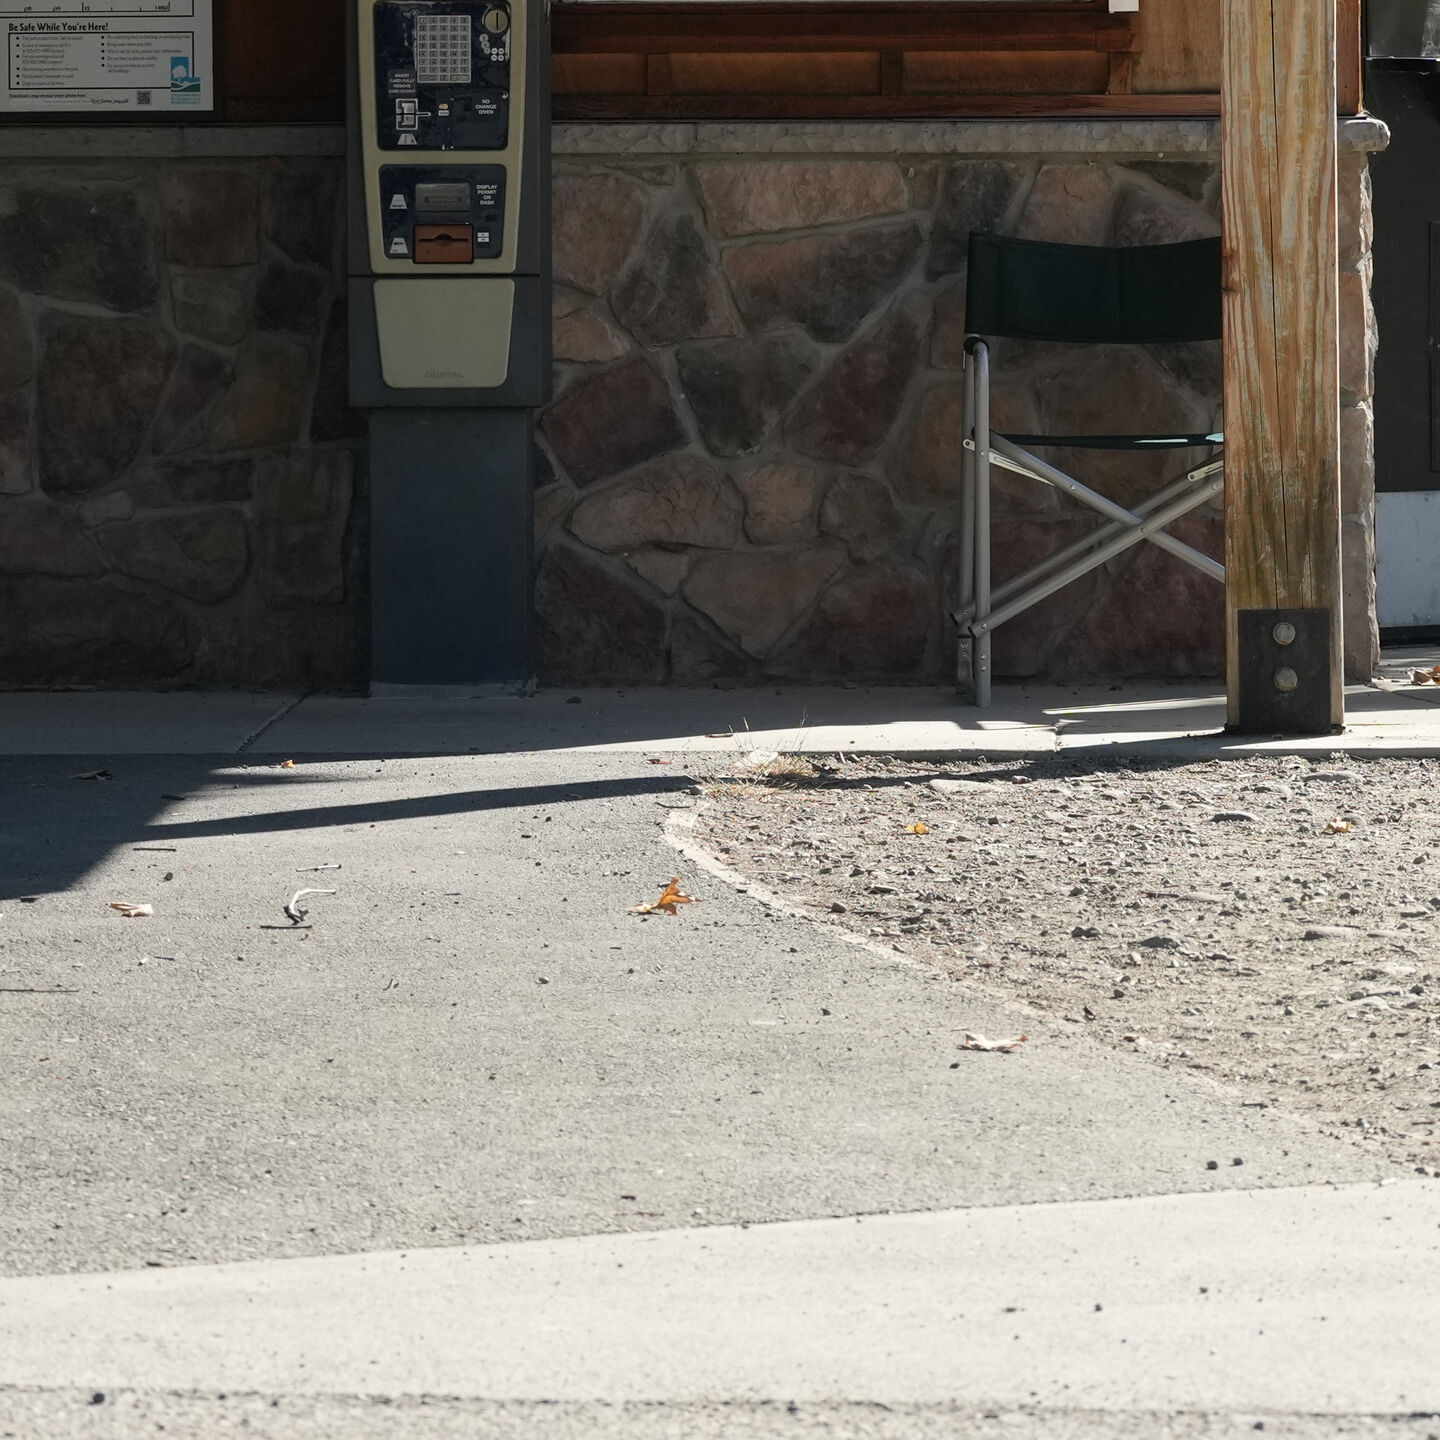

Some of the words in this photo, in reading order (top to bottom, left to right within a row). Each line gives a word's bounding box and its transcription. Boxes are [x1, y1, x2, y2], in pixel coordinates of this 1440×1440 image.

[8, 23, 18, 31] Be
[19, 23, 35, 31] Safe
[36, 23, 60, 31] While
